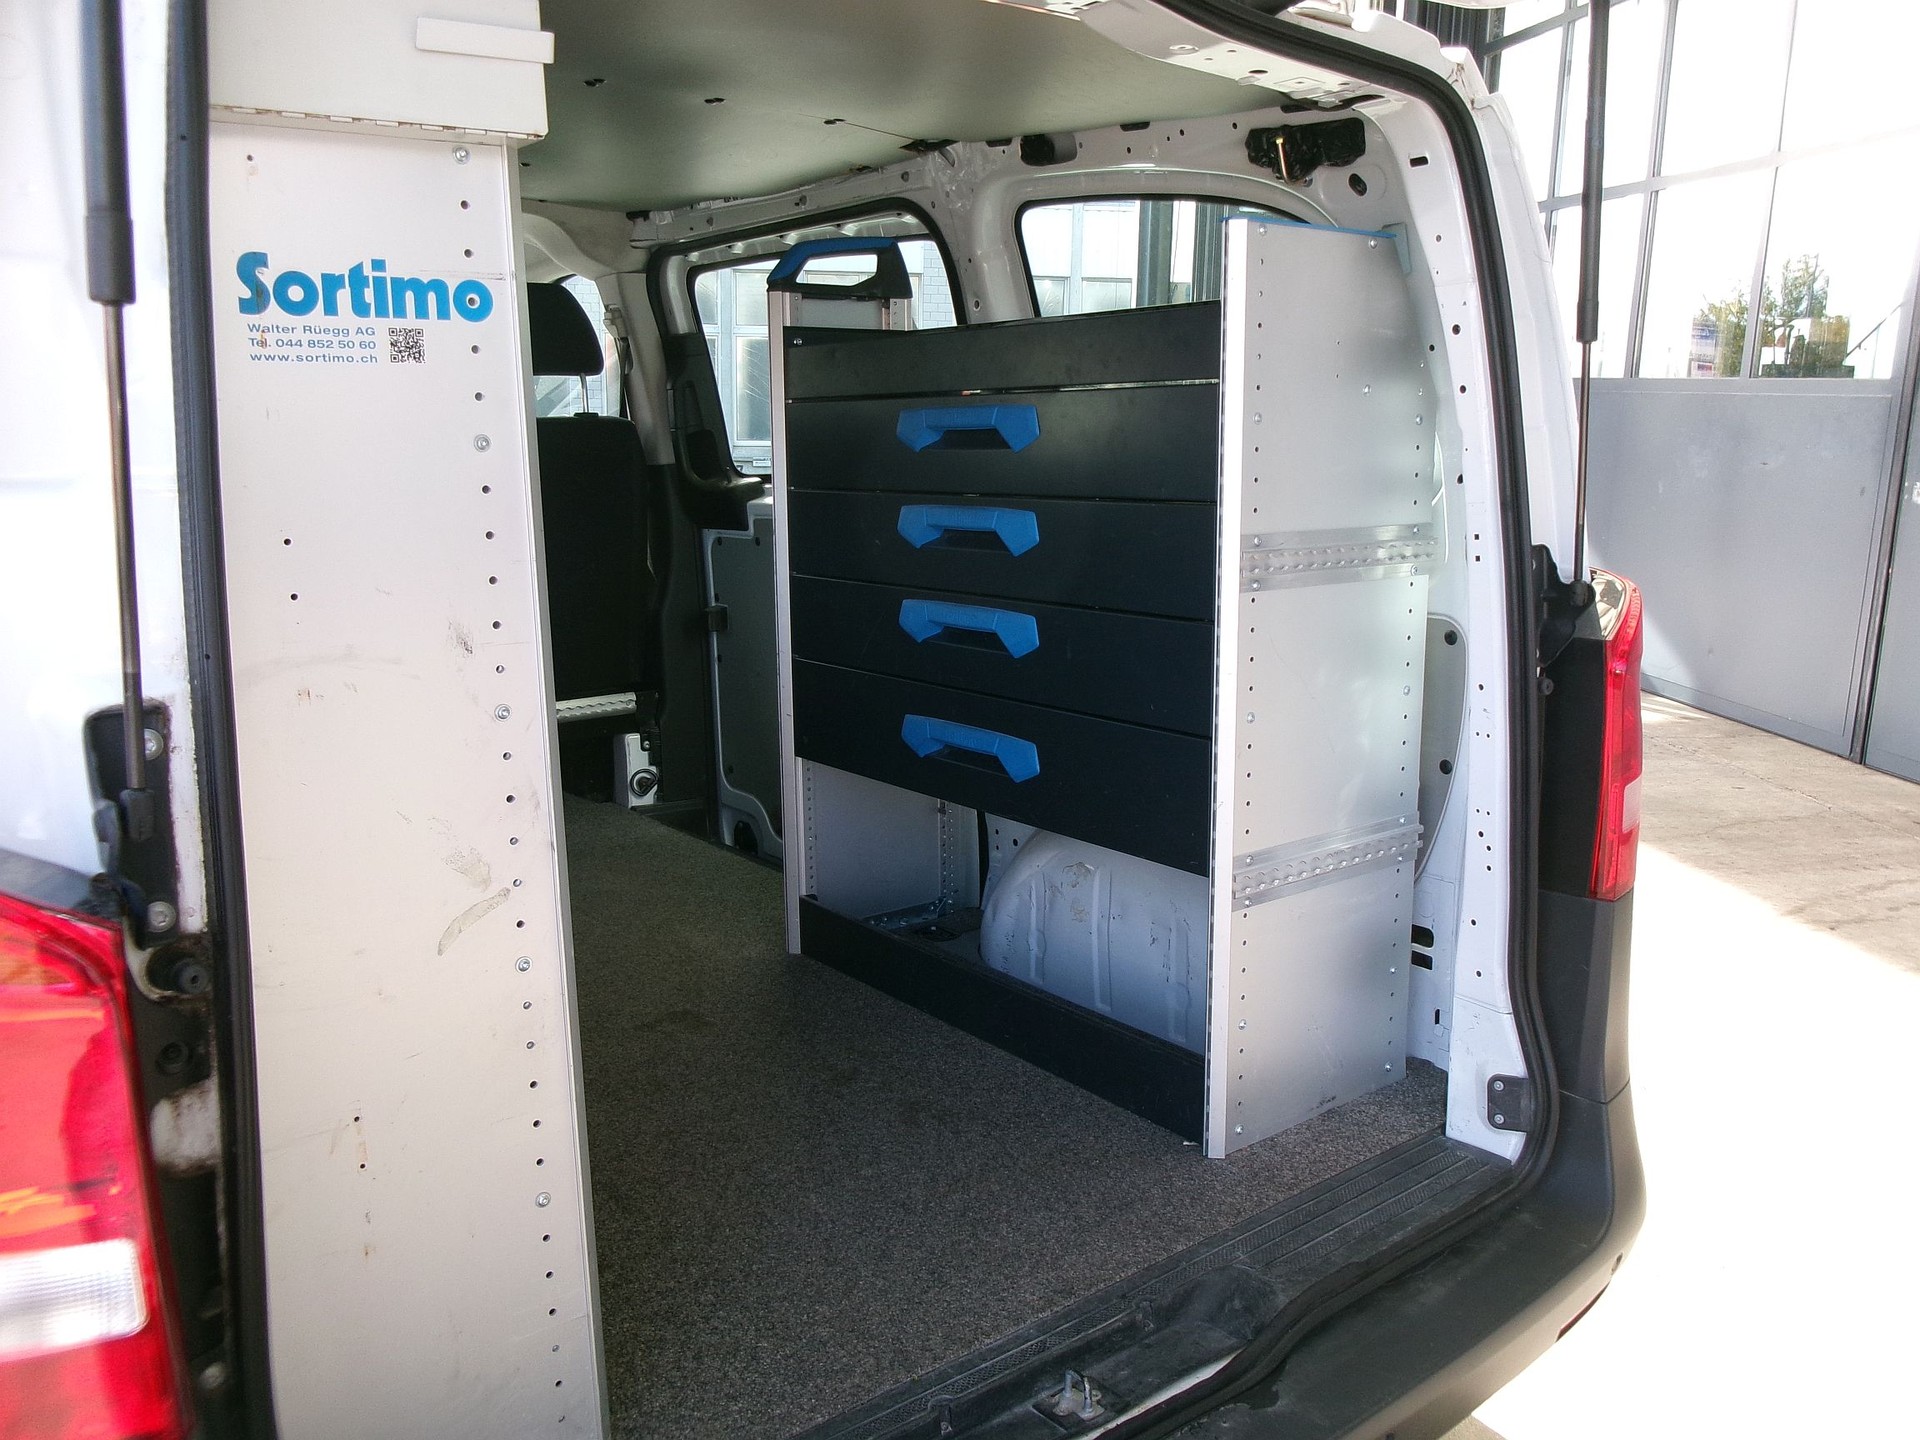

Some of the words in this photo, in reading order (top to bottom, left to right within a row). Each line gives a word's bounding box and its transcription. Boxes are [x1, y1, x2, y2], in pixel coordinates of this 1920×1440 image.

[236, 251, 494, 323] Sortimo
[247, 323, 297, 334] Walter
[302, 325, 350, 338] Rüegg
[355, 326, 376, 336] AG
[248, 337, 271, 348] Tel.
[275, 338, 303, 348] 044
[307, 339, 334, 349] 852
[338, 340, 355, 349] 50
[359, 340, 376, 350] 60
[250, 353, 378, 364] www.sortimo.ch
